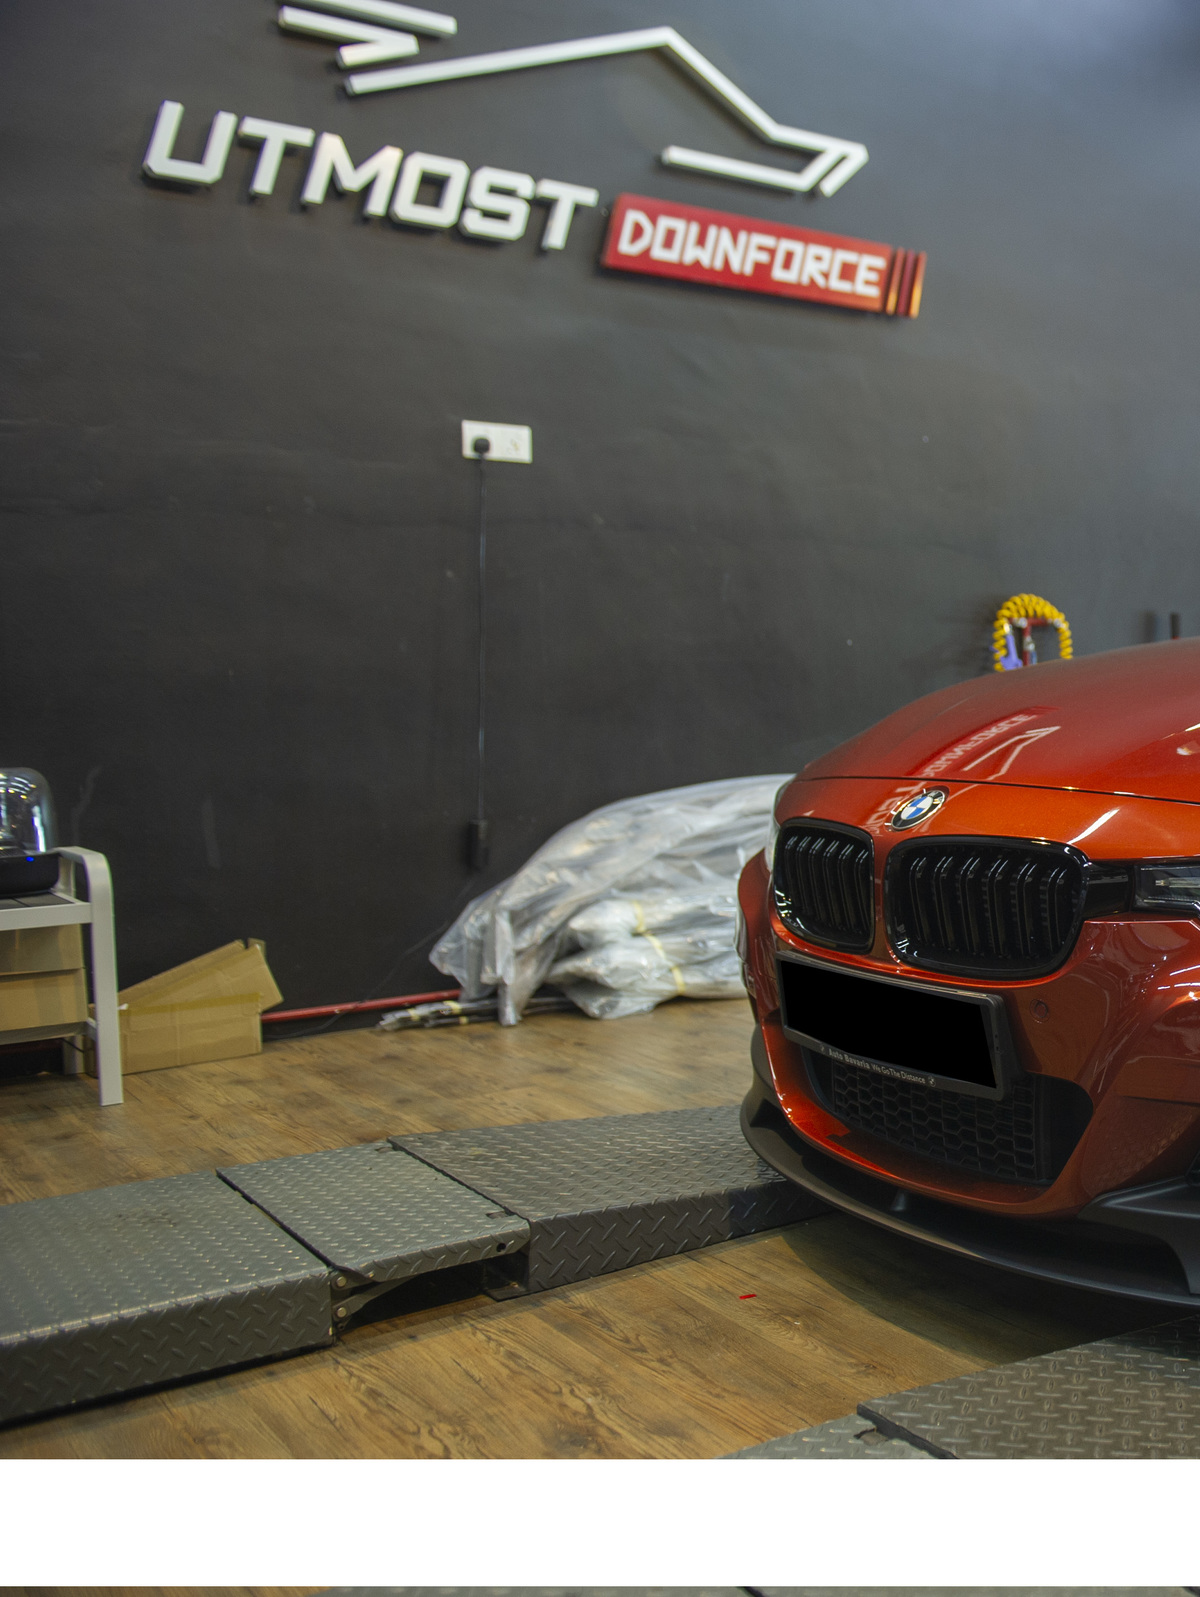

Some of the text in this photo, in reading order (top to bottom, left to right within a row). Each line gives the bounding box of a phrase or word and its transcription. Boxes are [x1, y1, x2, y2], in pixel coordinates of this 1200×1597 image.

[142, 100, 887, 299] UTMOST DOWNFORCE
[828, 1048, 926, 1084] Auto Bavaria We Go The Distance
